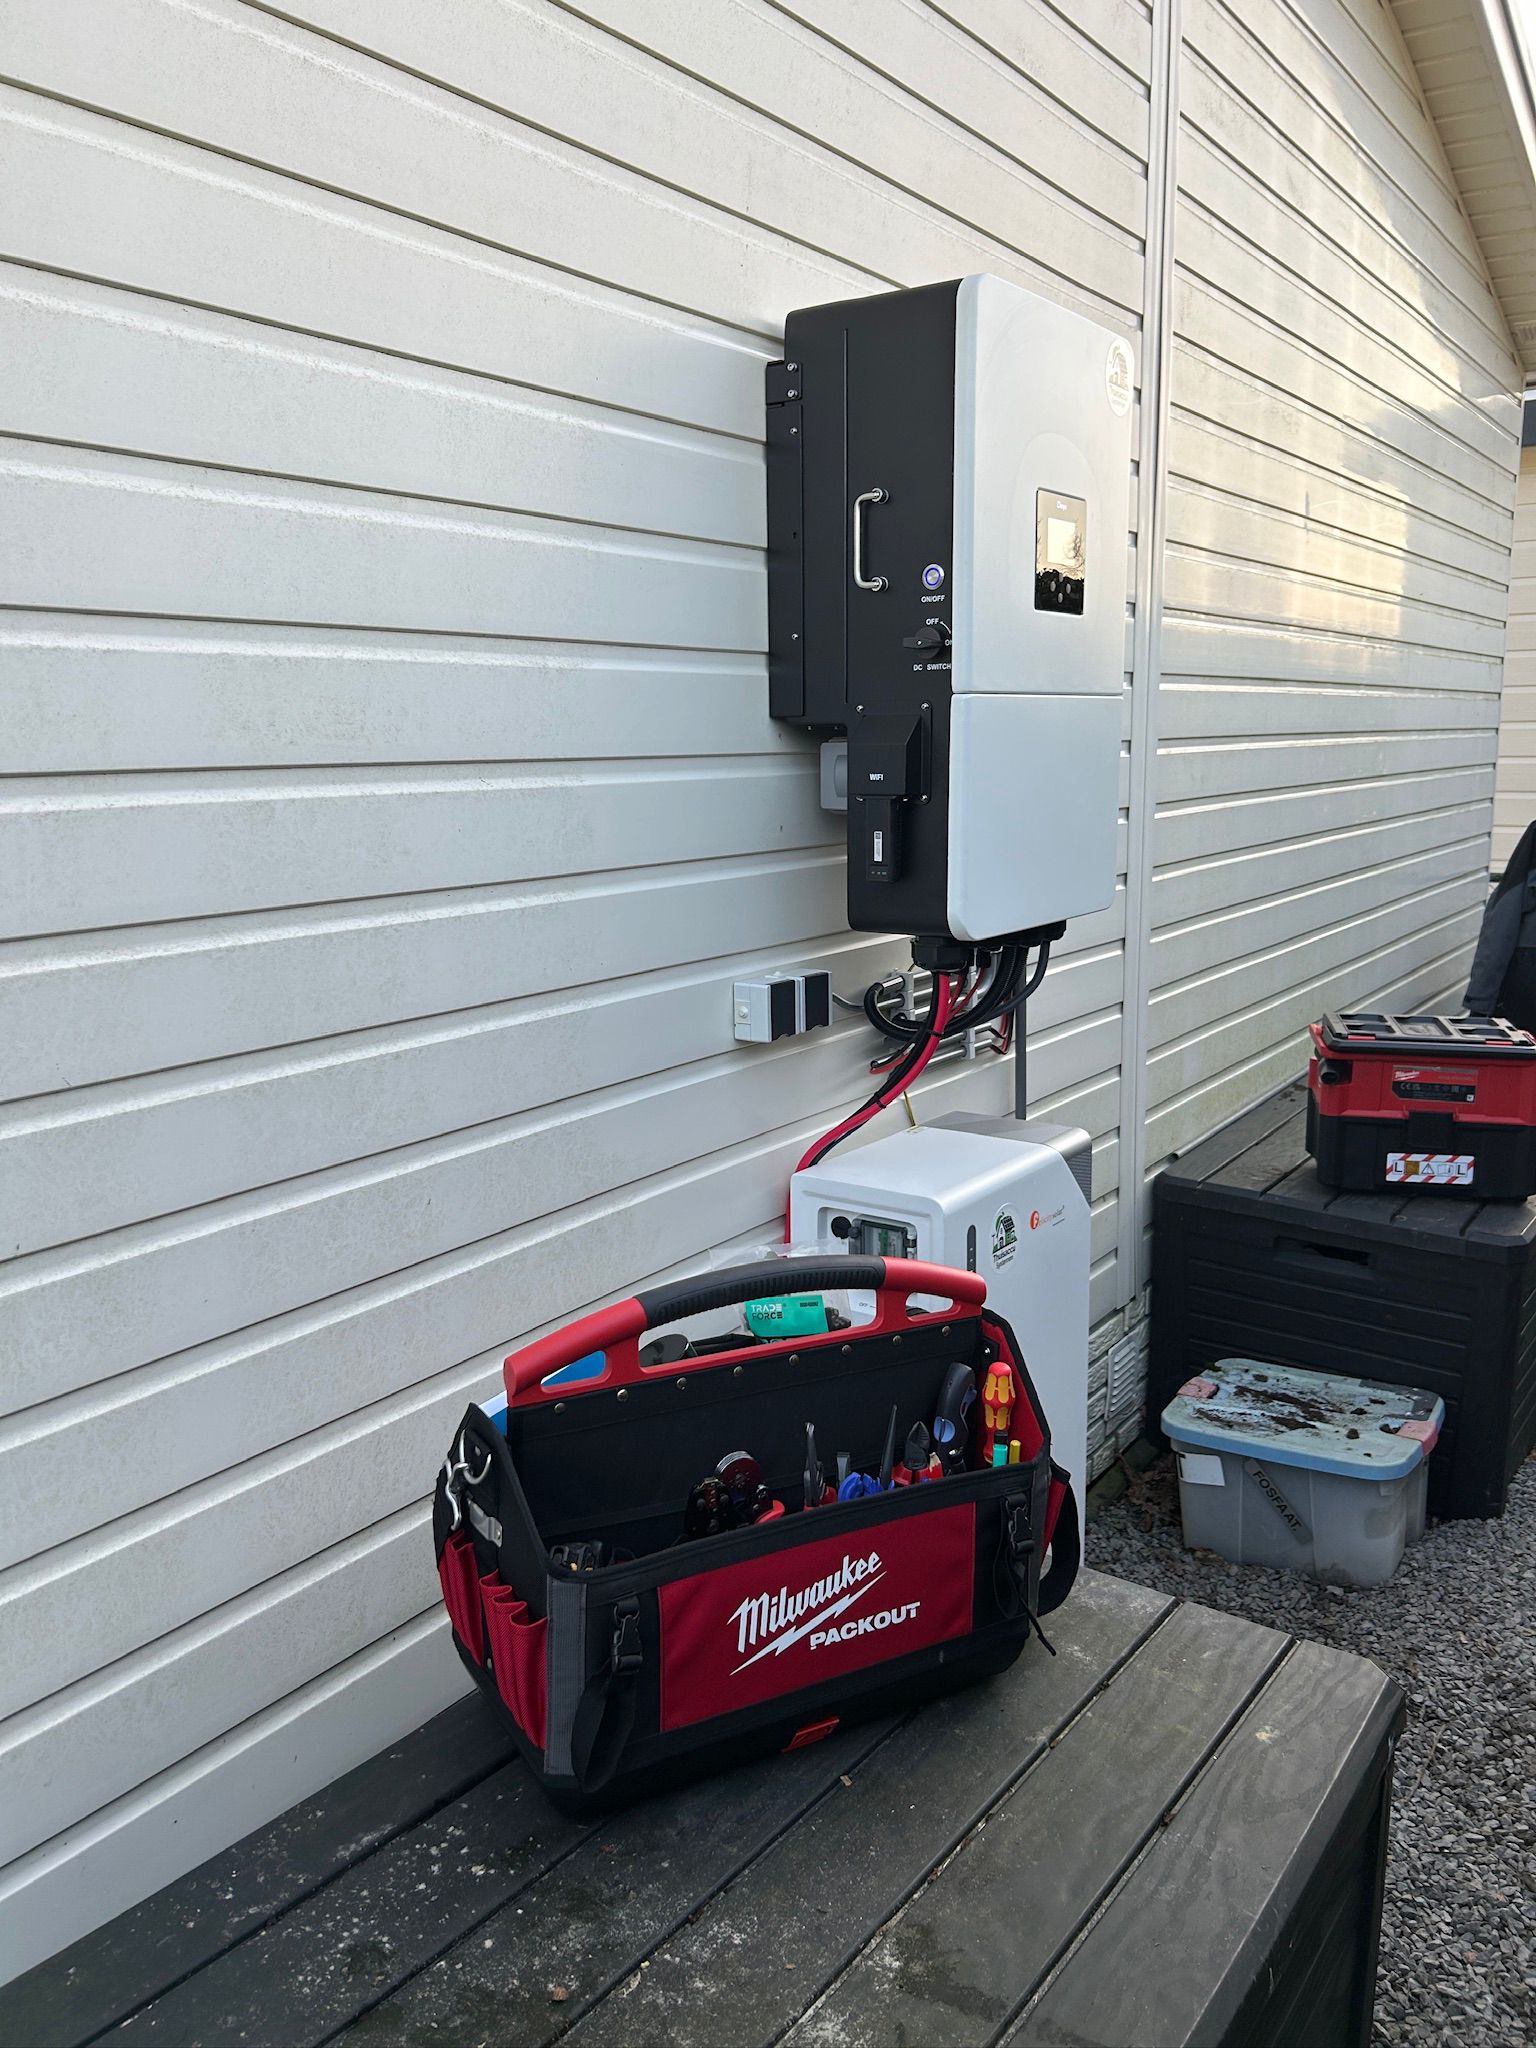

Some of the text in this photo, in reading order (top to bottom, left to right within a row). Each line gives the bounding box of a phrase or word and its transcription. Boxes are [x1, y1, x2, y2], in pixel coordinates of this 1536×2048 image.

[921, 595, 945, 603] ON/OFF
[750, 1303, 783, 1312] TRADE
[752, 1311, 783, 1320] FORCE
[726, 1551, 882, 1653] Milwaukee
[810, 1601, 921, 1650] PACKOUT
